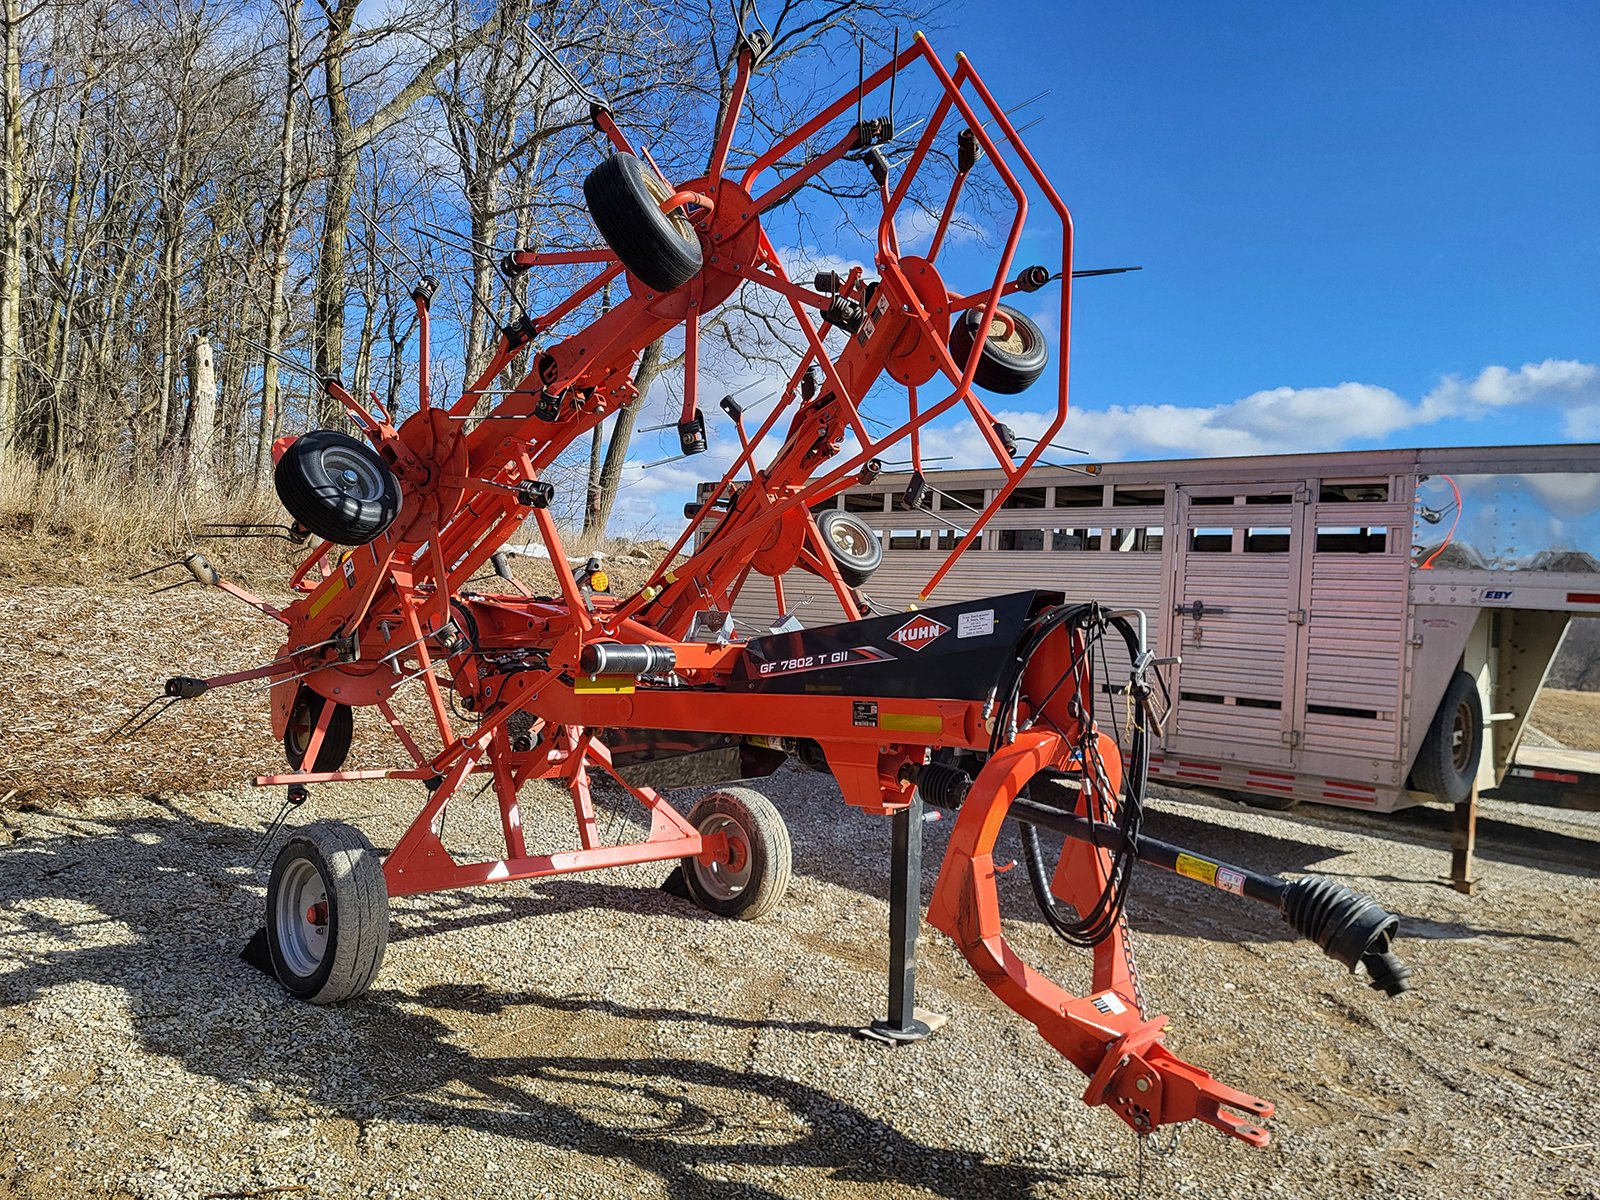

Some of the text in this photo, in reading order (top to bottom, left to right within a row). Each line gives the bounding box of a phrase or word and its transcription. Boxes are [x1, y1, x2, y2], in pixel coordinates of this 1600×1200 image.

[1485, 591, 1512, 599] EBY
[897, 625, 940, 642] KUHN
[760, 651, 848, 674] GF 7802 T GII
